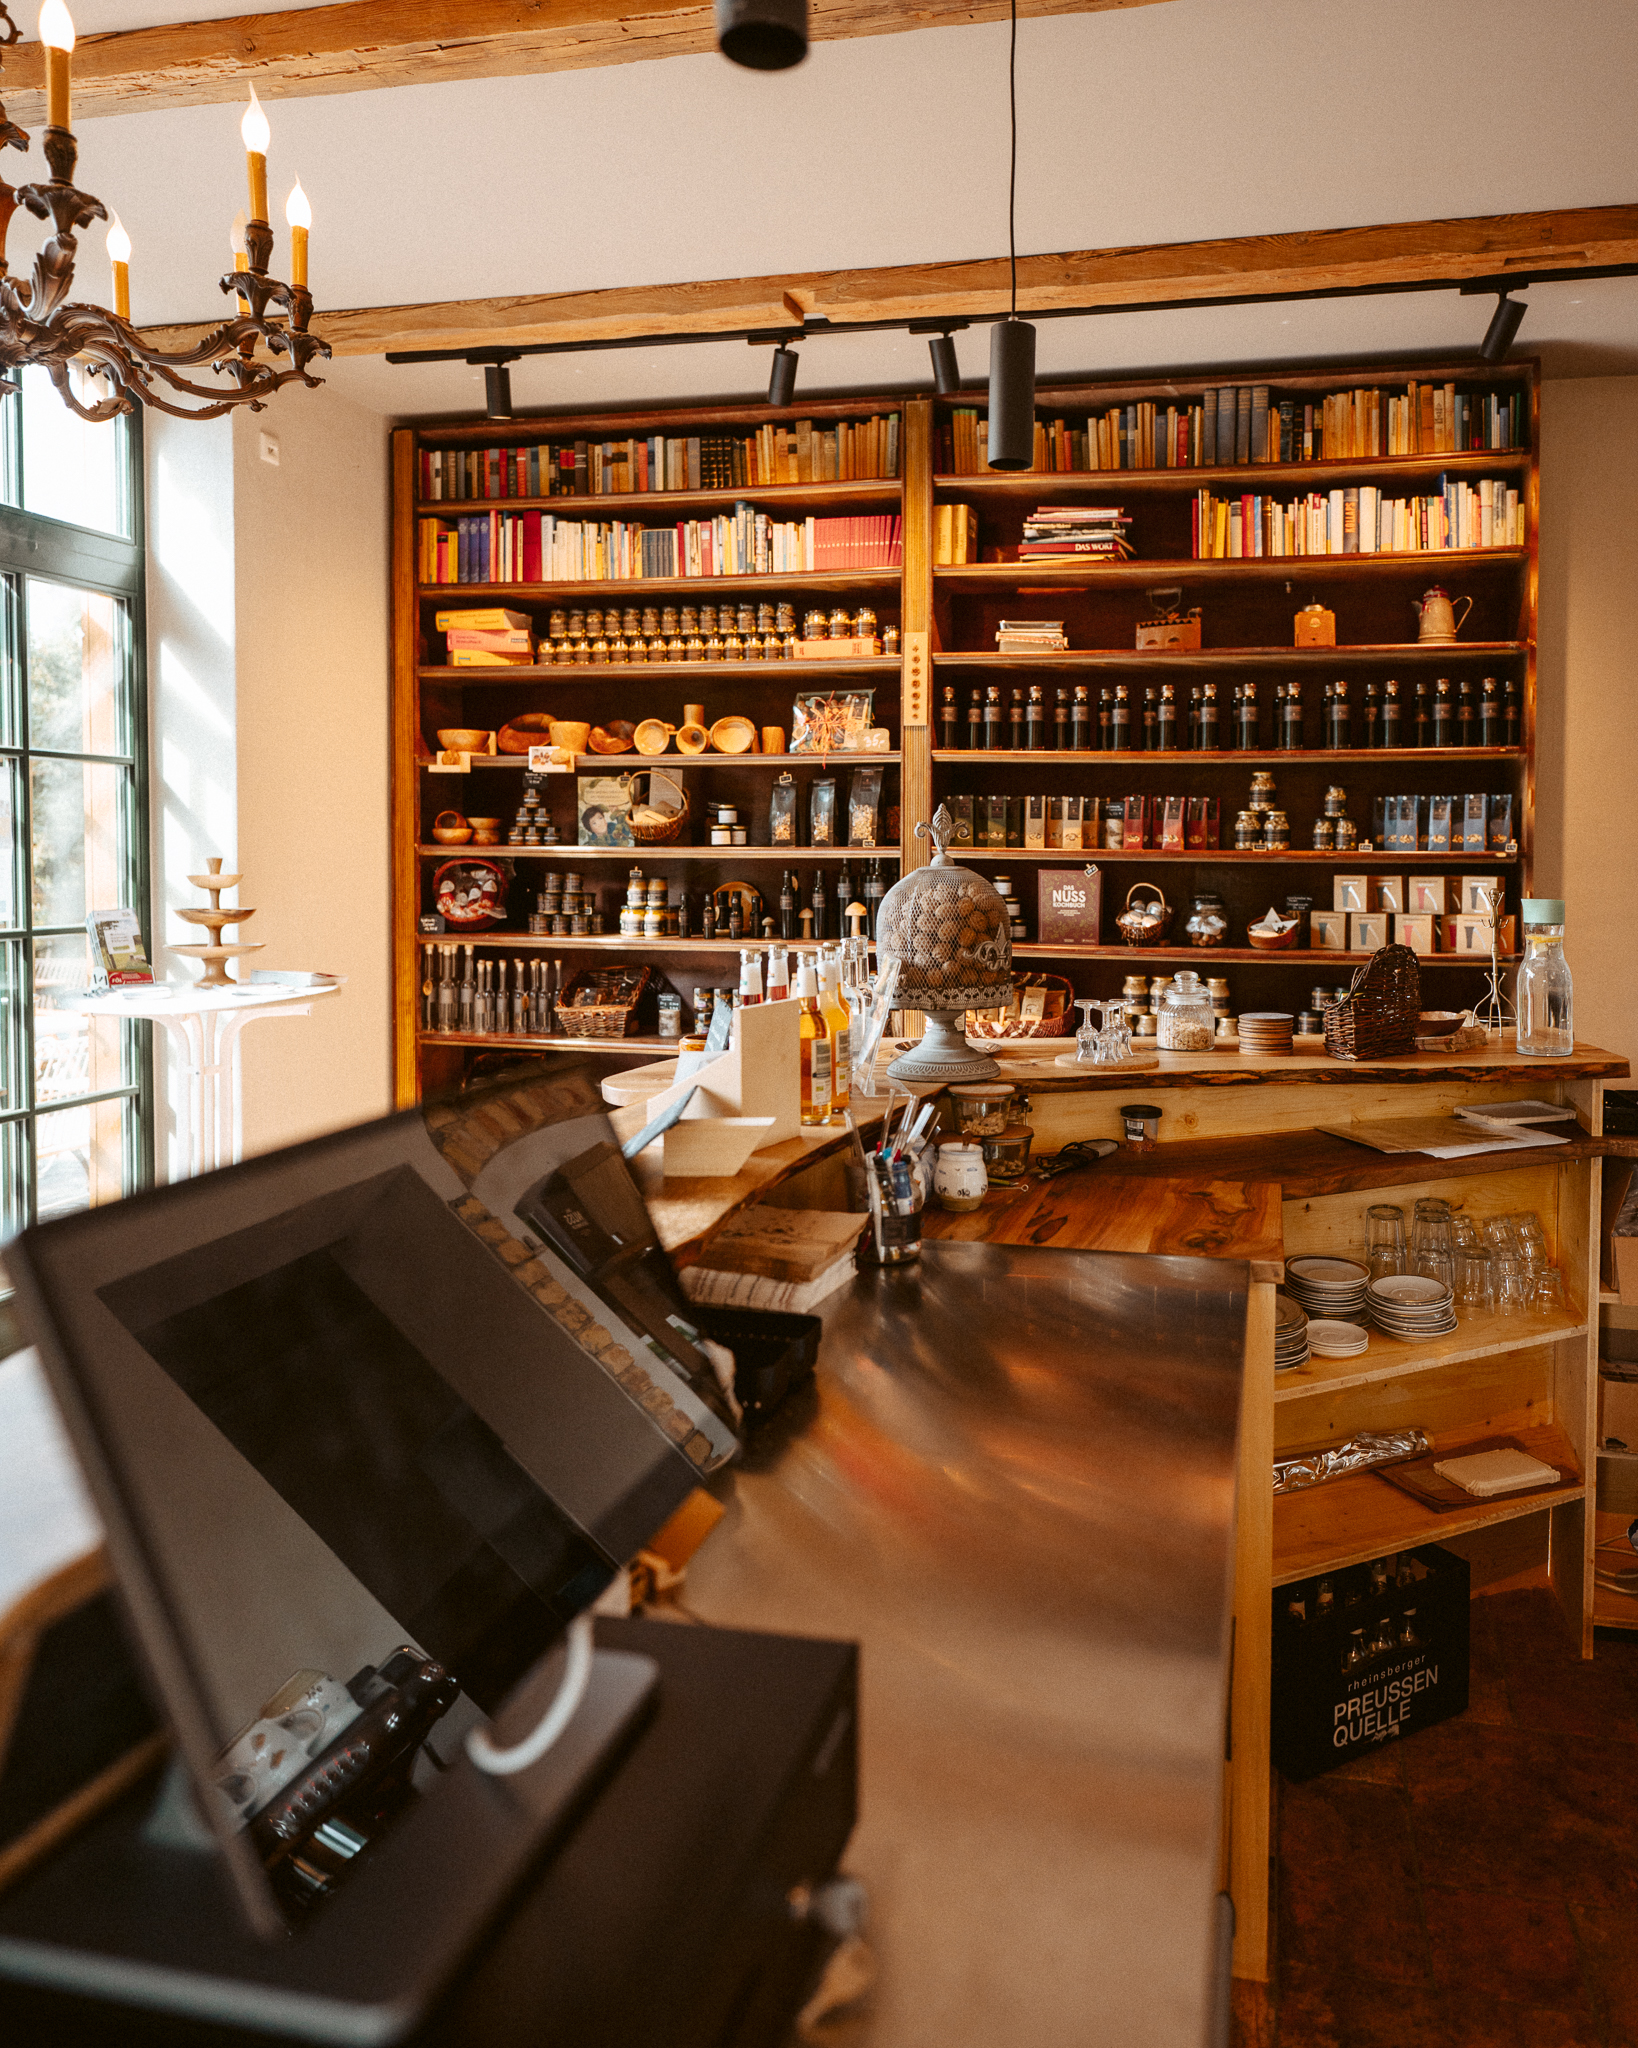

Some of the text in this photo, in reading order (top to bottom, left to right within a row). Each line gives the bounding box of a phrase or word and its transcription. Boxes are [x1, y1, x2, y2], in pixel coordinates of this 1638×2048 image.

[1344, 501, 1356, 533] KOLLAPS
[1074, 542, 1113, 551] DAS WORT
[1052, 889, 1087, 903] NUSS
[1348, 1653, 1427, 1692] rheinsberger
[1333, 1664, 1439, 1726] PREUSSEN
[1333, 1698, 1412, 1748] QUELLE
